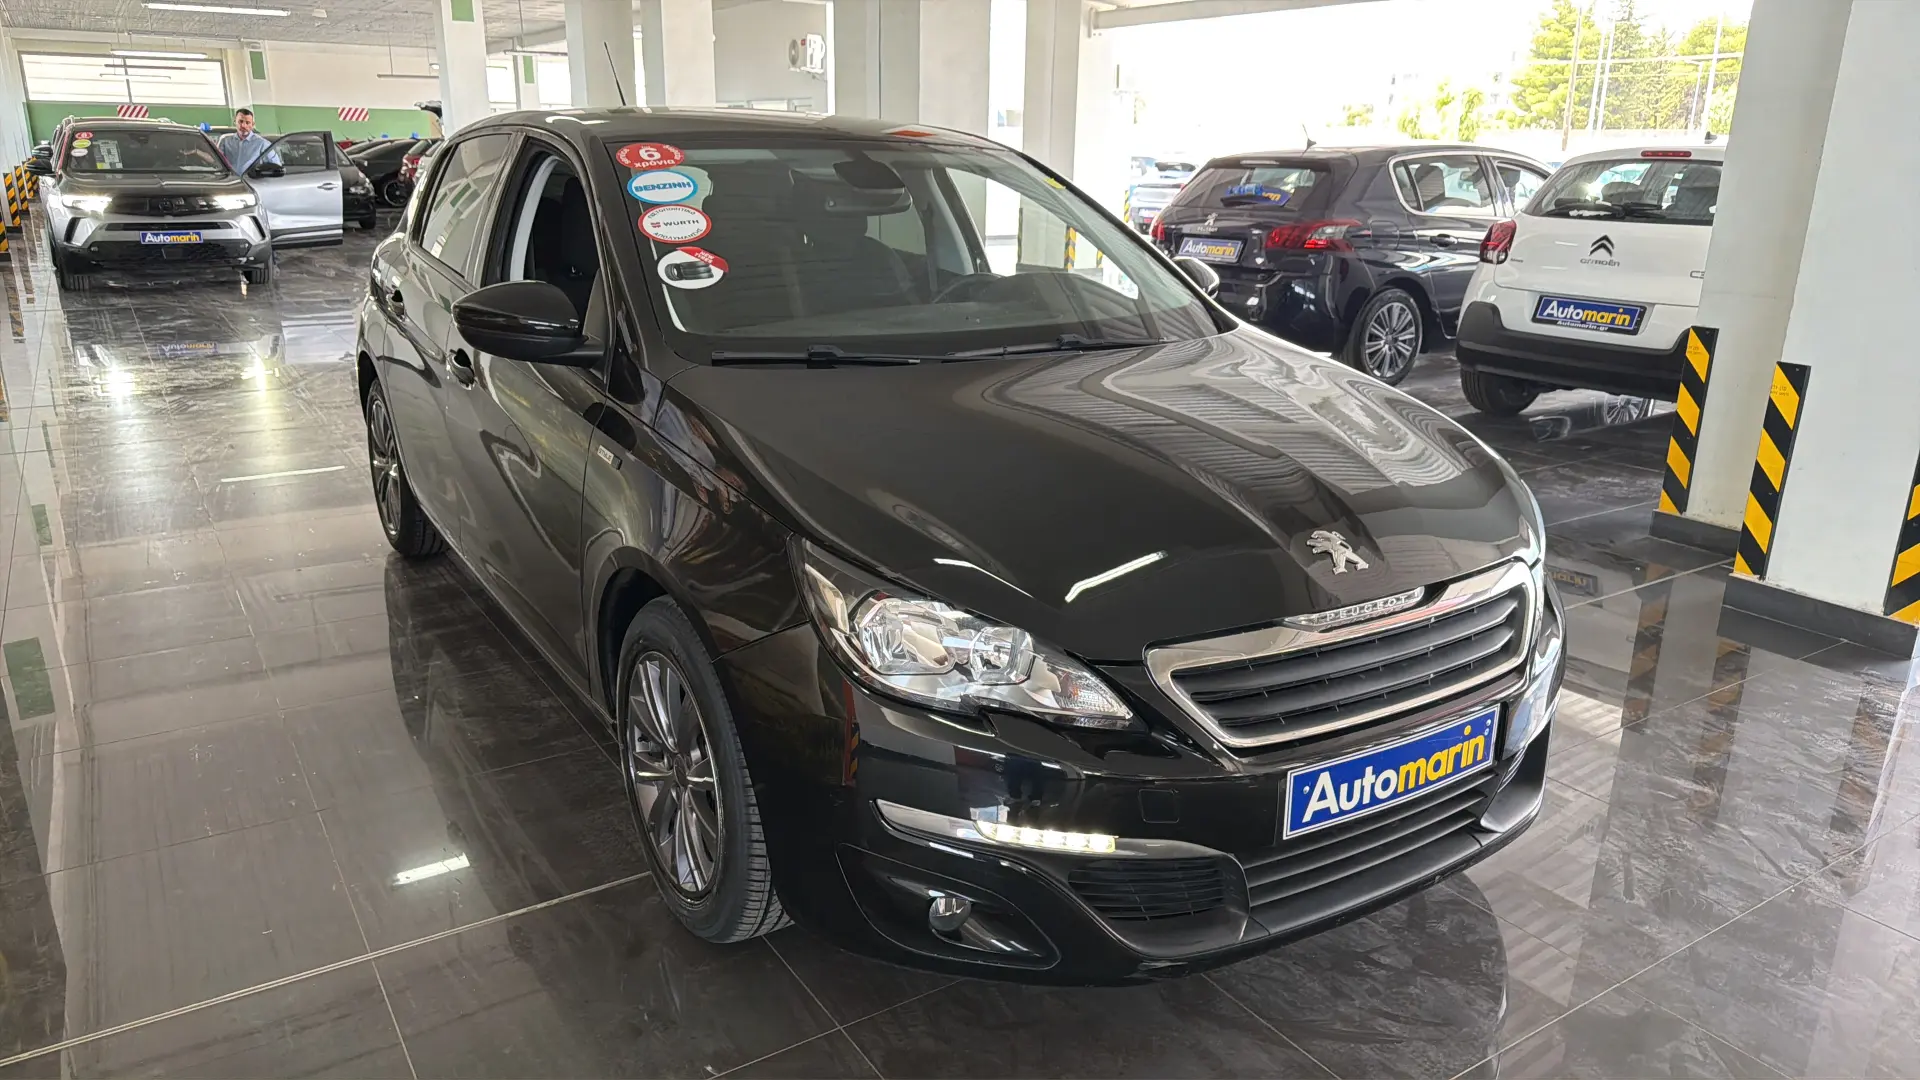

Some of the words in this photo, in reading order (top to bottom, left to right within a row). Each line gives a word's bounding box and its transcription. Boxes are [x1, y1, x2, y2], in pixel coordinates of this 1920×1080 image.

[639, 147, 661, 161] 6
[634, 159, 676, 169] χρόνια
[144, 231, 200, 243] Automarin
[1183, 240, 1235, 256] Automarin
[1543, 300, 1630, 327] Automarin
[1556, 320, 1609, 332] Automarin.gr
[1326, 595, 1407, 622] PEUGEOT
[1302, 725, 1485, 823] Automarin
